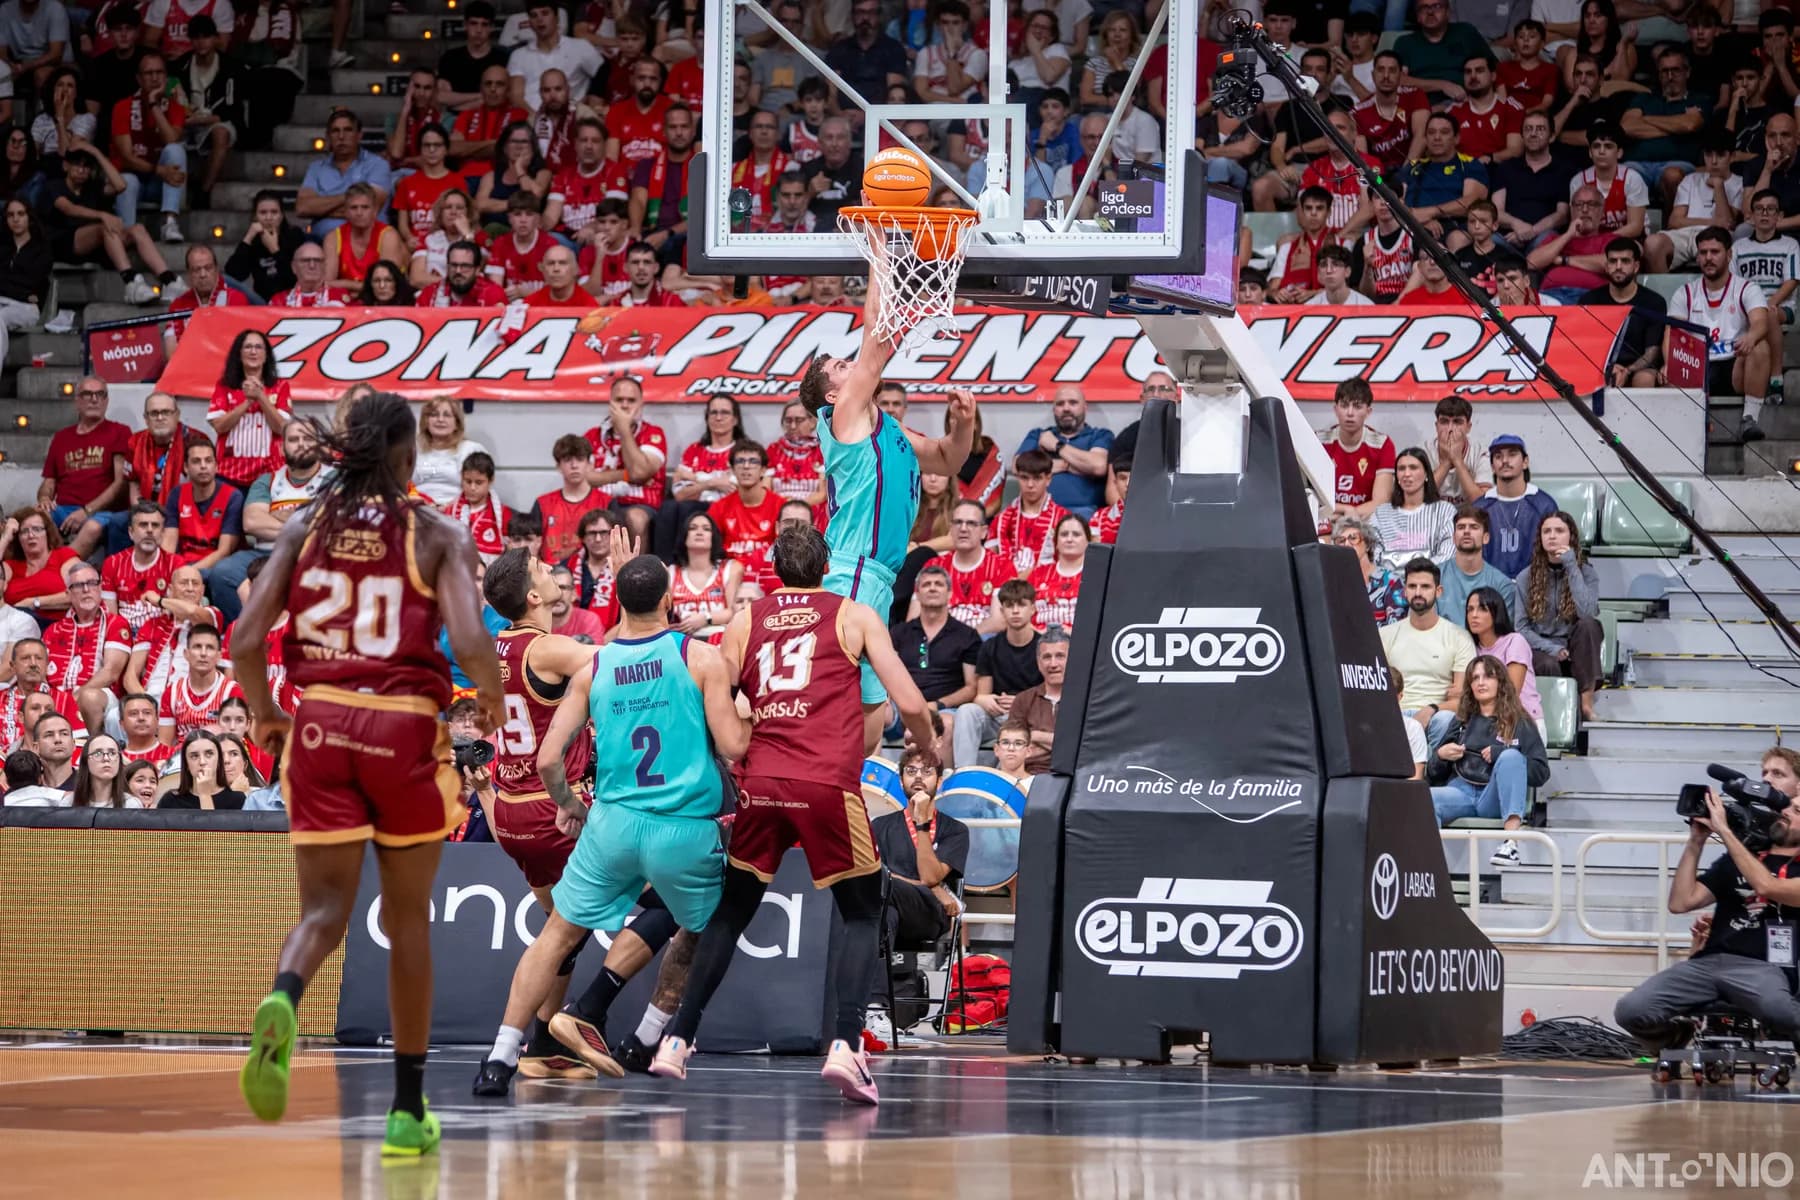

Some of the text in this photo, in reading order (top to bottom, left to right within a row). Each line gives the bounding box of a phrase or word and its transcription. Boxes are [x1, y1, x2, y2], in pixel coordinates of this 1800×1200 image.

[1101, 191, 1124, 204] liga
[1101, 203, 1152, 215] endesa
[1740, 258, 1784, 278] PARIS
[103, 343, 154, 362] MÓDULO
[266, 317, 581, 381] ZONA
[1673, 348, 1700, 369] MÓDULO
[123, 361, 137, 372] 11
[1681, 368, 1690, 380] 11
[686, 374, 783, 395] PASIÓN
[1500, 527, 1520, 553] 10
[296, 566, 404, 660] 20
[614, 659, 663, 686] MARTIN
[755, 631, 817, 698] 13
[1341, 656, 1387, 691] INVERSUS
[628, 696, 651, 707] BARÇA
[629, 700, 670, 713] FOUNDATION
[631, 725, 666, 788] 2
[1087, 774, 1302, 800] Uno más de la familia
[783, 801, 810, 809] MURCIA
[1404, 871, 1436, 898] LABASA
[1369, 949, 1501, 995] LET'S GO BEYOND
